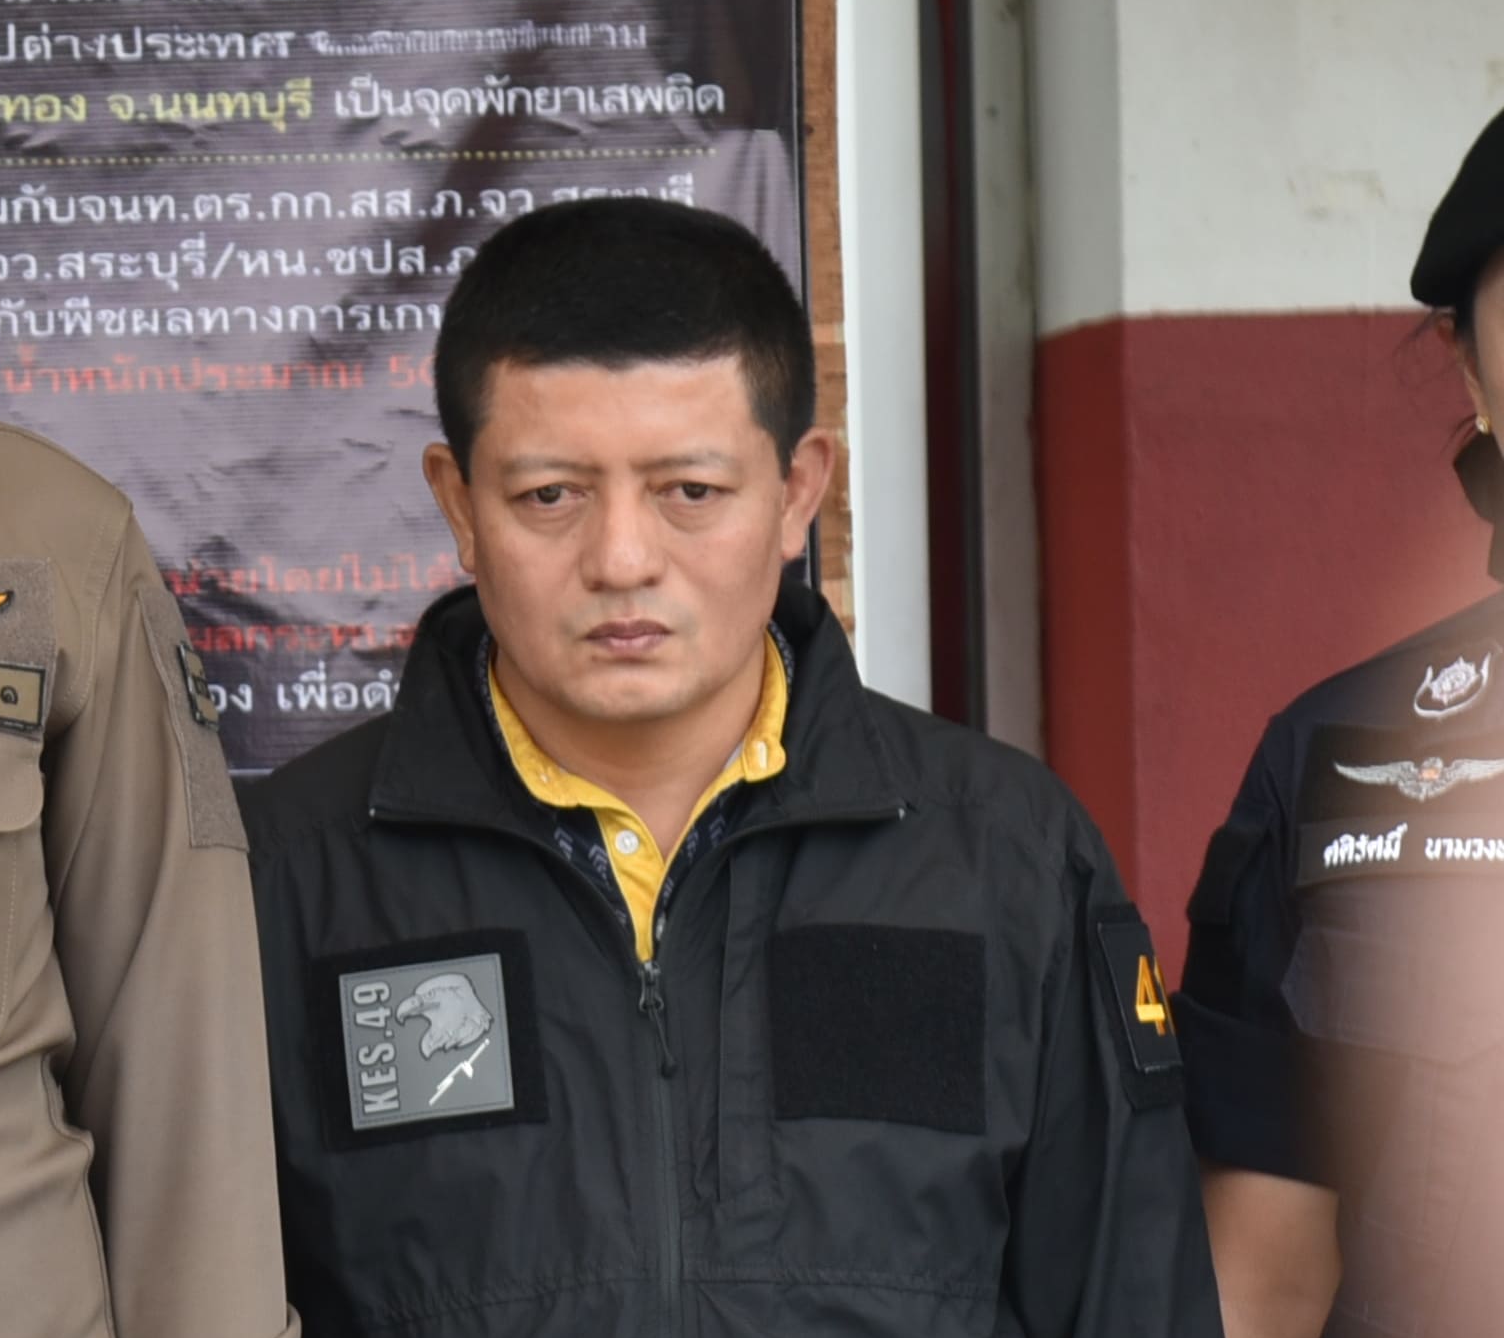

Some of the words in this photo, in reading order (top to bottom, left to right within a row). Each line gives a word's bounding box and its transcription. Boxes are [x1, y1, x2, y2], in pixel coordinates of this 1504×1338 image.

[108, 77, 314, 133] จ.นนทบุรี
[276, 661, 400, 712] เพื่อดำ
[352, 980, 401, 1114] KES.49
